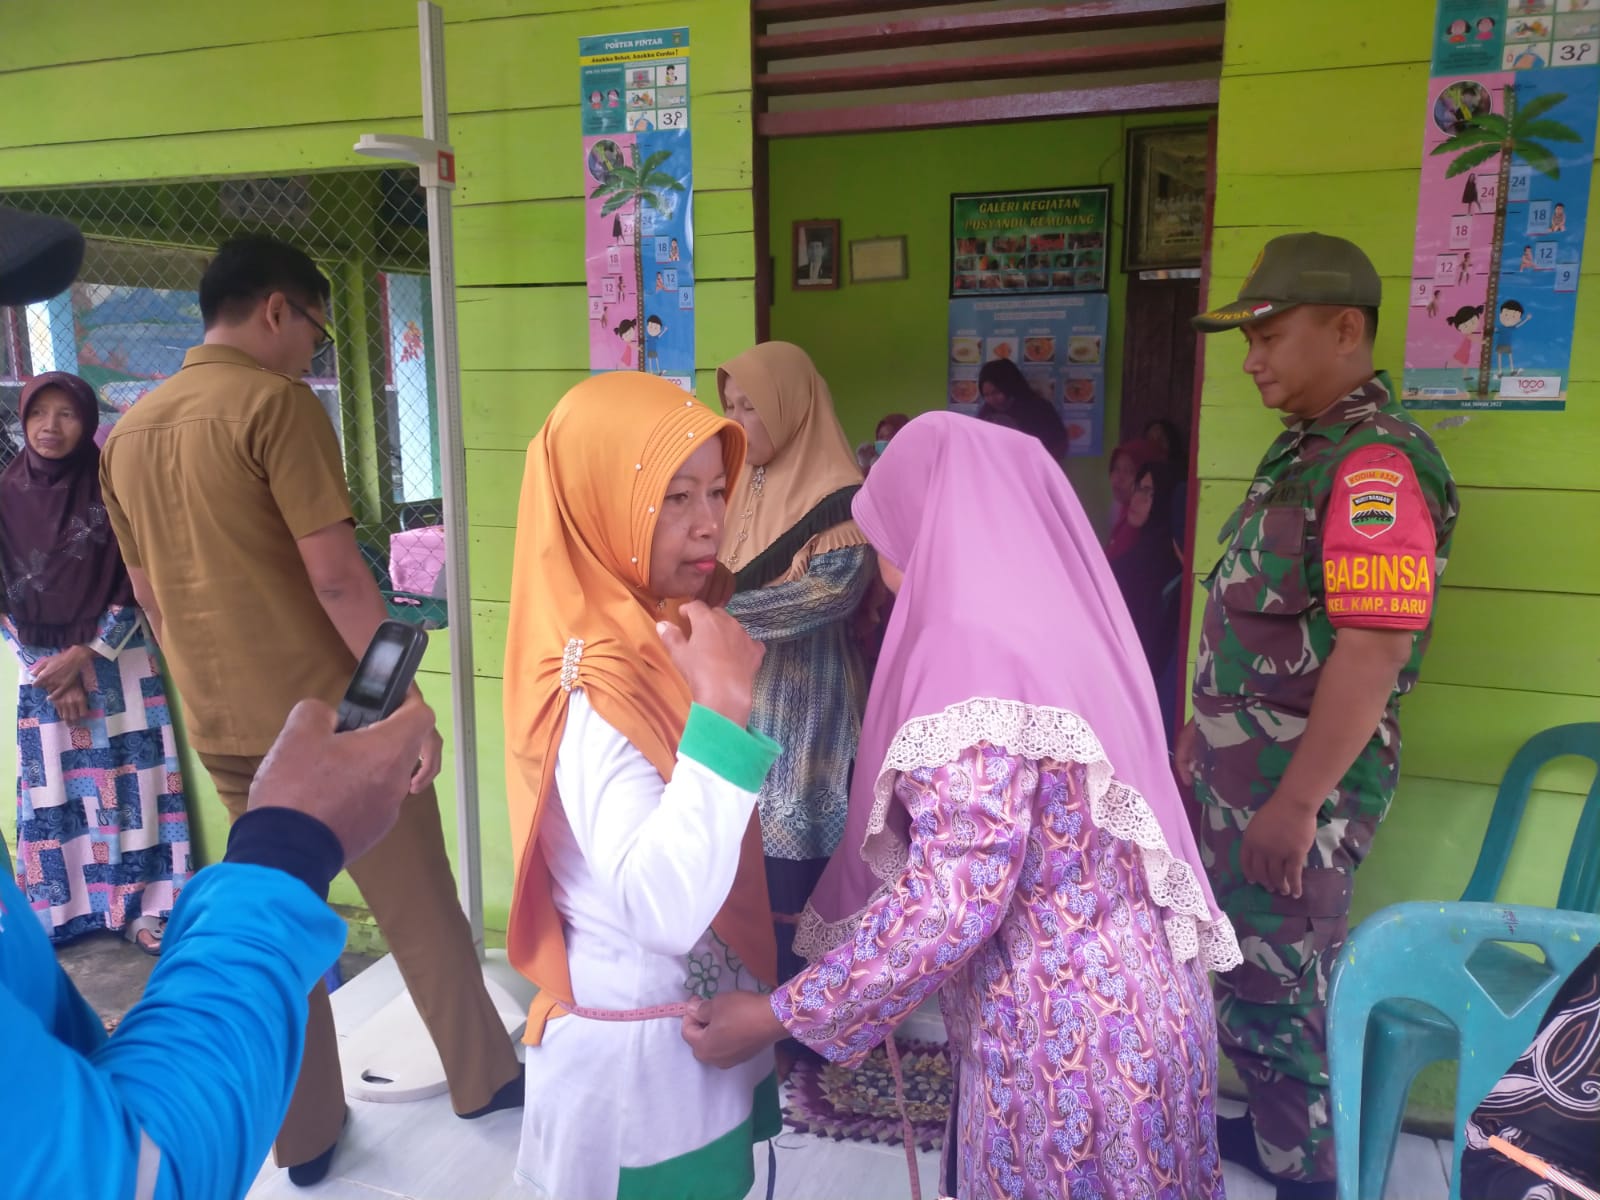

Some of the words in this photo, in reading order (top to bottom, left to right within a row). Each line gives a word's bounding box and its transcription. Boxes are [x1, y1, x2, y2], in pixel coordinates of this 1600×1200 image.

[1512, 176, 1526, 188] 24
[1480, 187, 1495, 198] 24
[979, 201, 1019, 214] GALERI
[1022, 198, 1080, 211] KEGIATAN
[1533, 209, 1546, 220] 18
[1029, 214, 1095, 227] KEMUNING
[1456, 225, 1468, 236] 18
[658, 243, 667, 253] 18
[1540, 248, 1553, 258] 12
[1441, 262, 1453, 272] 12
[666, 273, 675, 283] 12
[1563, 271, 1570, 282] 9
[604, 283, 613, 293] 12
[1419, 284, 1426, 295] 9
[683, 292, 689, 301] 9
[1518, 379, 1545, 389] 1000
[1325, 555, 1430, 593] BABINSA
[1328, 597, 1348, 613] KEL.
[1351, 597, 1387, 613] KMP.
[1390, 598, 1427, 614] BARU
